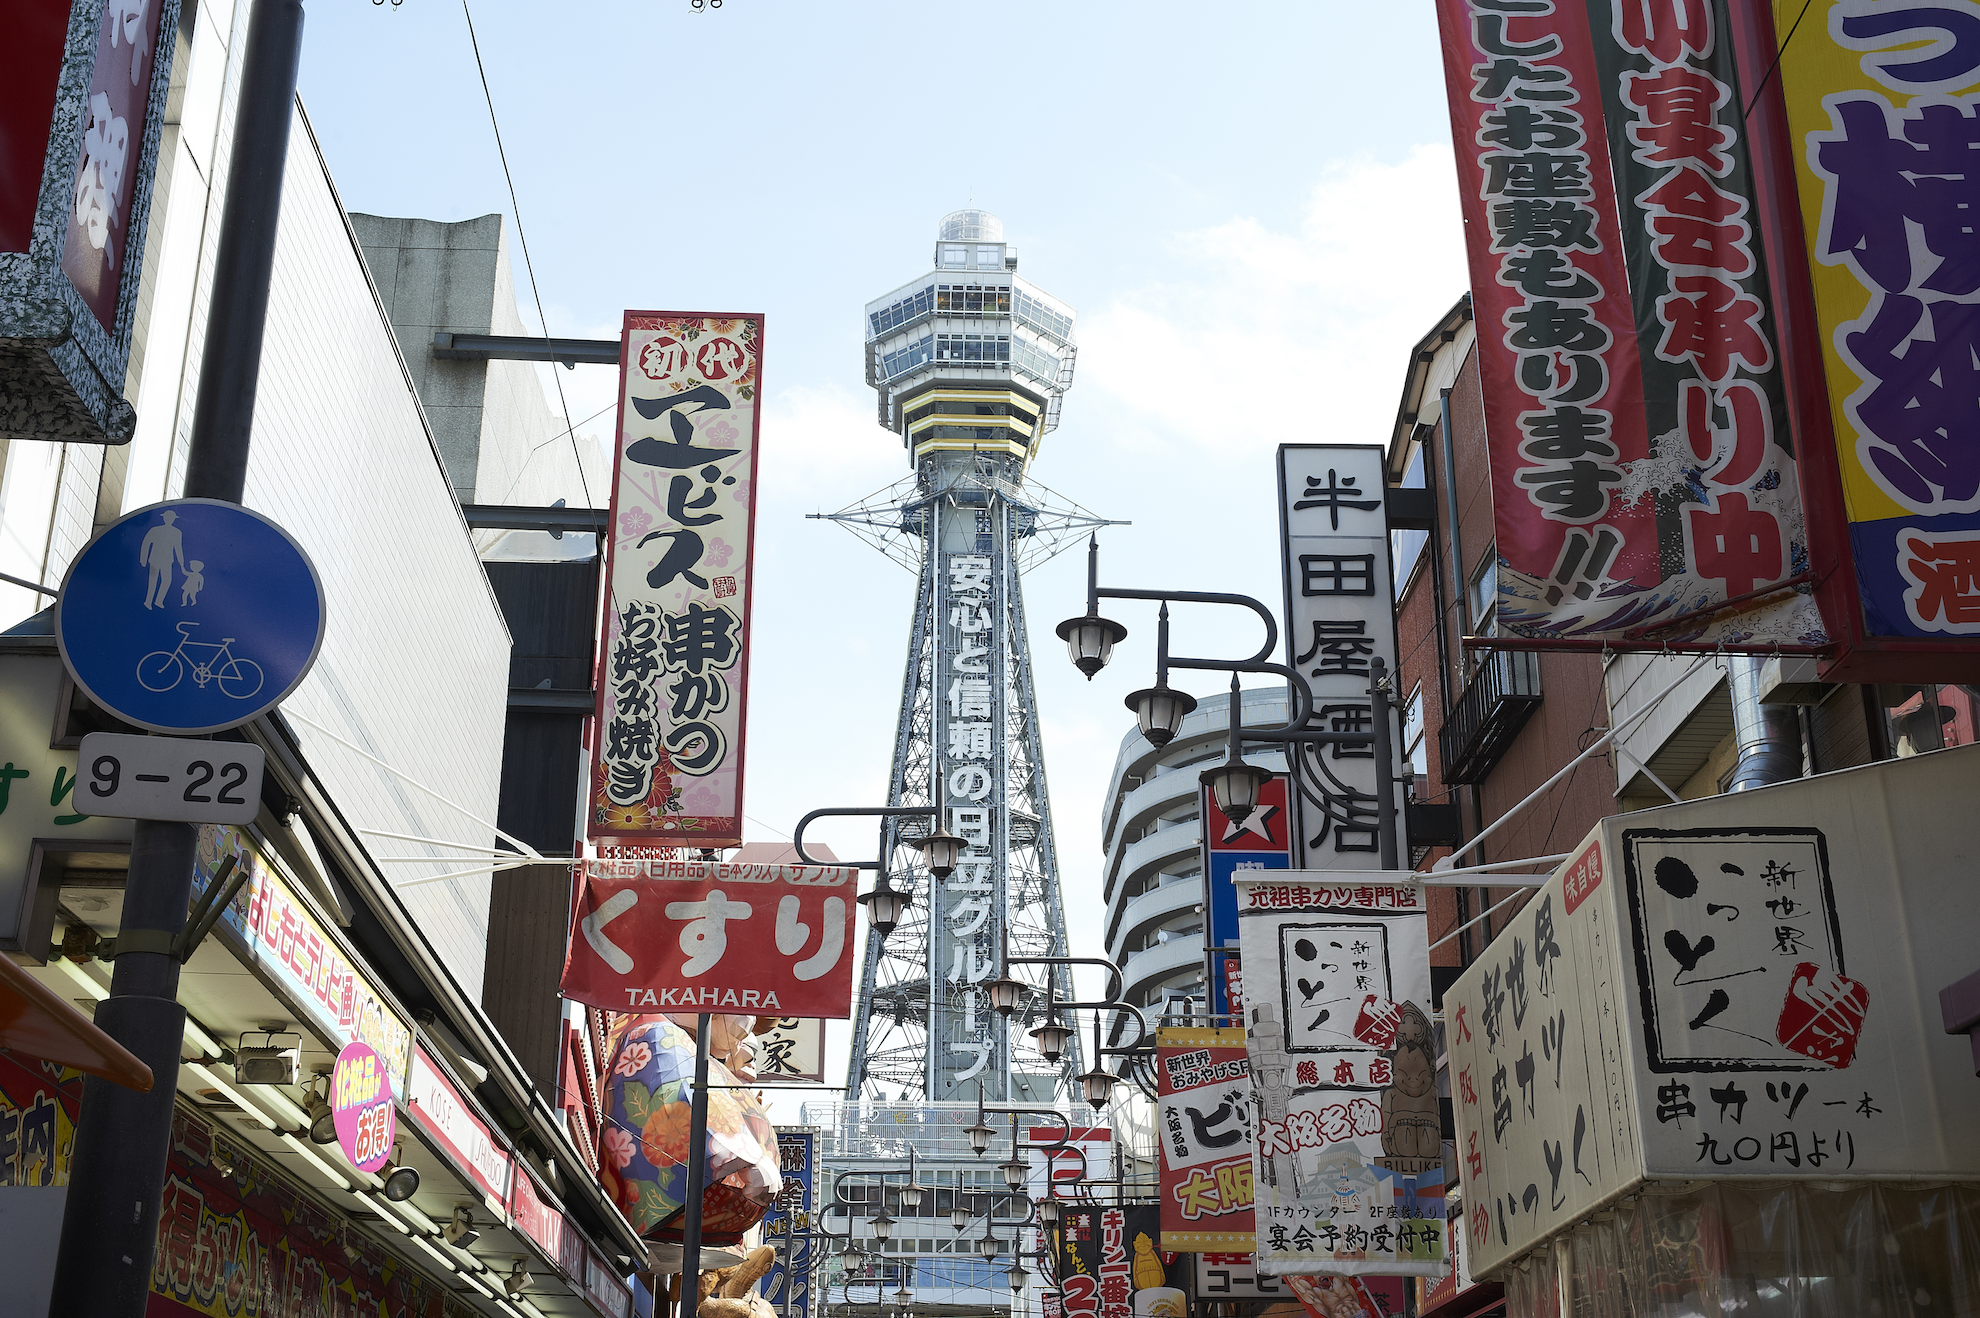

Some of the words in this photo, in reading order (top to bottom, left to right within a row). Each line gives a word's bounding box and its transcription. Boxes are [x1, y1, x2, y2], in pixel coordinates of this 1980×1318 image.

[642, 338, 745, 379] 初代
[606, 601, 664, 806] お好み焼き
[662, 601, 742, 776] 串かつ
[947, 554, 994, 1081] 安心と信頼の日立グループ
[1248, 885, 1418, 909] 元祖串カツ専門店
[1565, 844, 1602, 904] 味自慢
[581, 889, 846, 982] くすり
[1760, 859, 1815, 956] 新世界
[1350, 939, 1376, 992] 新世界
[1480, 892, 1562, 1054] 新世界
[625, 987, 782, 1009] TAKAHARA
[1166, 1050, 1211, 1073] 新世界
[1296, 1057, 1392, 1085] 総本店
[1492, 1009, 1565, 1150] 串カツ
[355, 1098, 394, 1165] お得!
[1257, 1098, 1383, 1158] 大阪名物
[1454, 1000, 1491, 1250] 大阪名物
[1656, 1077, 1809, 1130] 串カツ
[1822, 1091, 1883, 1119] 一本
[1497, 1104, 1592, 1246] いっとく
[1266, 1224, 1440, 1255] 宴会予約受付中
